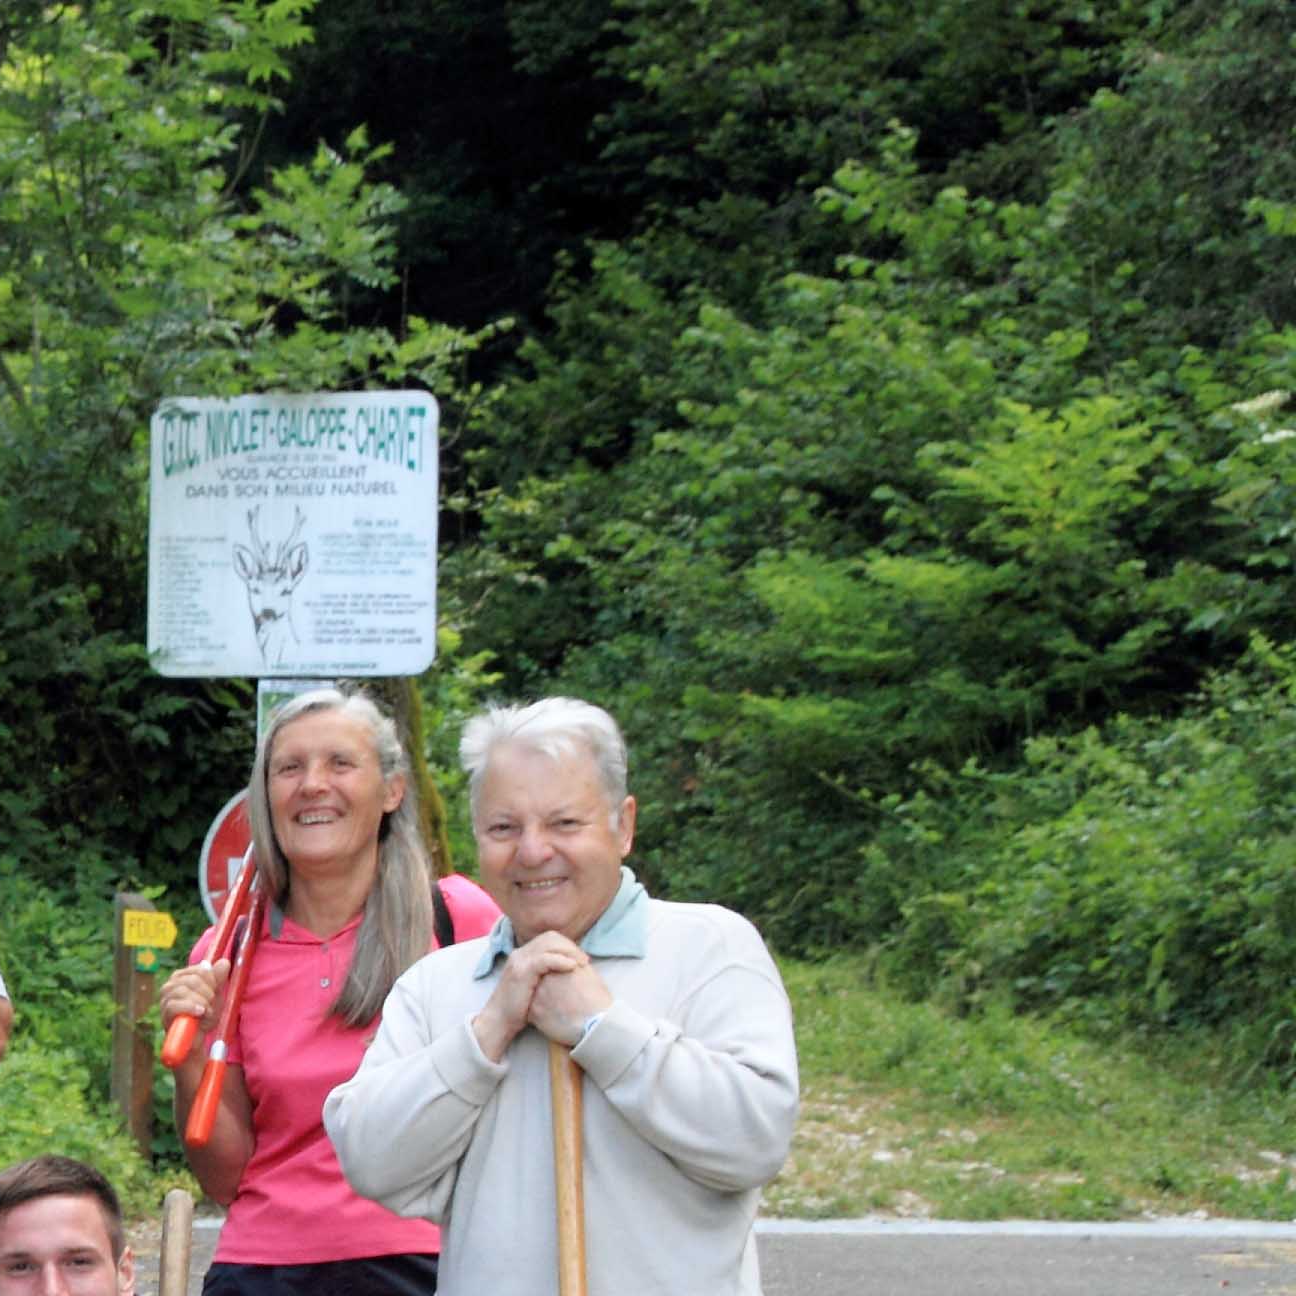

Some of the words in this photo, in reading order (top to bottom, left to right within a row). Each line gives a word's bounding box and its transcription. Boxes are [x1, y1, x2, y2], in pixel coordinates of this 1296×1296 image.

[218, 466, 258, 480] VOUS
[267, 465, 367, 480] ACCUEILLENT
[185, 484, 229, 498] DANS
[235, 484, 268, 497] SON
[275, 483, 325, 497] MILIEU
[331, 481, 398, 496] NATUREL
